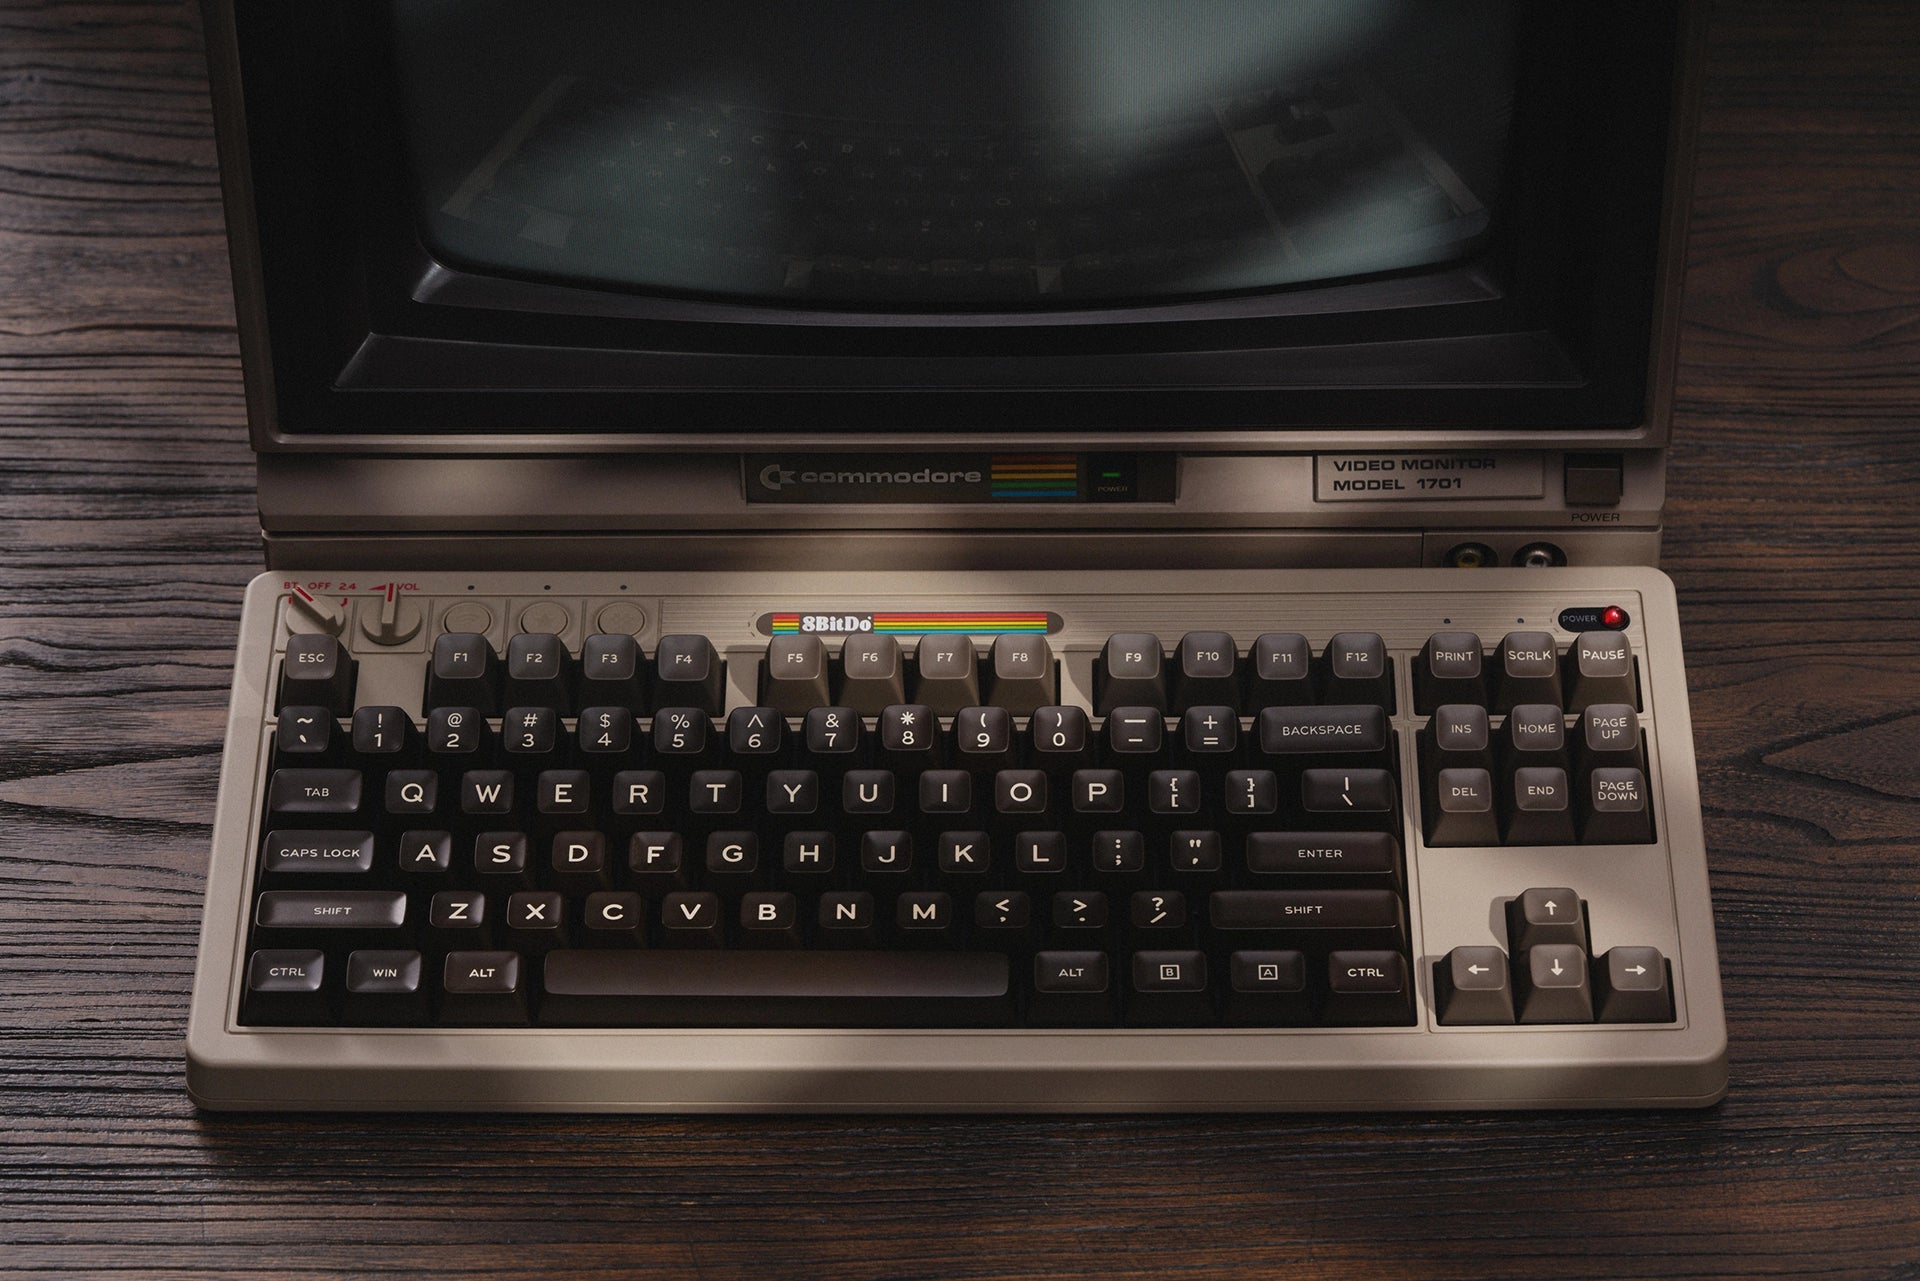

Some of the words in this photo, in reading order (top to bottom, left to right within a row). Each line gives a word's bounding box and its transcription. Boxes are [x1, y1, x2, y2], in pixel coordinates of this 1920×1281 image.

[1333, 459, 1395, 472] VIDEO
[1401, 457, 1496, 471] MONITOR
[800, 468, 982, 485] commodore
[1097, 485, 1129, 493] POWER
[1333, 478, 1406, 492] MODEL
[1416, 477, 1463, 490] 1701
[1570, 512, 1621, 523] POWER
[307, 581, 332, 590] OFF
[397, 583, 420, 591] VOL
[801, 615, 873, 632] 8BitDo
[1562, 614, 1598, 623] POWER
[298, 653, 325, 663] ESC
[453, 652, 468, 662] F1
[526, 653, 543, 663] F2
[601, 653, 618, 664] F3
[675, 654, 693, 664] F4
[787, 653, 804, 663] F5
[862, 652, 879, 663] F6
[937, 652, 954, 663] F7
[1012, 652, 1029, 662] F8
[1125, 652, 1142, 663] F9
[1196, 651, 1220, 661] F10
[1272, 653, 1292, 663] F11
[1346, 652, 1368, 662] F12
[1435, 651, 1474, 662] PRINT
[1508, 650, 1552, 661] SCRLK
[1582, 648, 1625, 661] PAUSE
[377, 713, 383, 728] !
[447, 712, 463, 728] @
[522, 713, 538, 728] #
[599, 712, 611, 729] $
[670, 713, 690, 730] %
[747, 713, 764, 728] ^
[825, 713, 840, 728] &
[980, 712, 987, 728] (
[1056, 712, 1063, 727] )
[1202, 715, 1218, 730] +
[1592, 716, 1628, 728] PAGE
[1282, 724, 1362, 736] BACKSPACE
[1451, 724, 1472, 734] INS
[1518, 723, 1556, 734] HOME
[1601, 728, 1622, 739] UP
[374, 733, 382, 748] 1
[446, 733, 460, 748] 2
[521, 733, 535, 748] 3
[597, 732, 612, 747] 4
[672, 733, 685, 748] 5
[748, 733, 762, 748] 6
[824, 732, 837, 747] 7
[901, 730, 915, 745] 8
[976, 732, 990, 748] 9
[1052, 732, 1066, 747] 0
[1203, 737, 1219, 745] =
[304, 787, 330, 797] TAB
[400, 783, 424, 803] Q
[475, 784, 502, 803] W
[554, 783, 573, 803] E
[705, 783, 727, 803] T
[783, 783, 802, 803] Y
[859, 783, 878, 803] U
[942, 783, 948, 803] I
[1009, 782, 1032, 802] O
[1088, 782, 1107, 802] P
[1451, 787, 1478, 797] DEL
[1527, 785, 1555, 795] END
[1598, 781, 1636, 791] PAGE
[629, 784, 649, 804] R
[1171, 793, 1179, 808] [
[1247, 794, 1255, 808] ]
[1341, 793, 1353, 806] \
[1597, 791, 1639, 801] DOWN
[1115, 838, 1121, 849] :
[280, 848, 318, 858] CAPS
[323, 848, 360, 858] LOCK
[415, 844, 437, 862] A
[492, 844, 511, 863] S
[568, 844, 589, 863] D
[647, 845, 665, 864] F
[722, 844, 743, 863] G
[799, 844, 819, 863] H
[878, 845, 896, 863] J
[954, 844, 974, 863] K
[1032, 844, 1050, 862] L
[1115, 854, 1122, 866] ;
[1297, 849, 1343, 858] ENTER
[313, 907, 352, 915] SHIFT
[448, 903, 469, 920] Z
[525, 903, 546, 920] X
[679, 903, 702, 920] V
[836, 903, 856, 920] N
[912, 903, 936, 920] M
[995, 898, 1010, 912] <
[1072, 899, 1088, 912] >
[1152, 896, 1164, 912] ?
[1284, 905, 1323, 915] SHIFT
[602, 903, 624, 921] C
[758, 903, 777, 921] B
[1150, 910, 1167, 924] /
[269, 967, 306, 977] CTRL
[372, 968, 397, 978] WIN
[468, 968, 495, 978] ALT
[1058, 968, 1084, 977] ALT
[1347, 968, 1385, 978] CTRL
